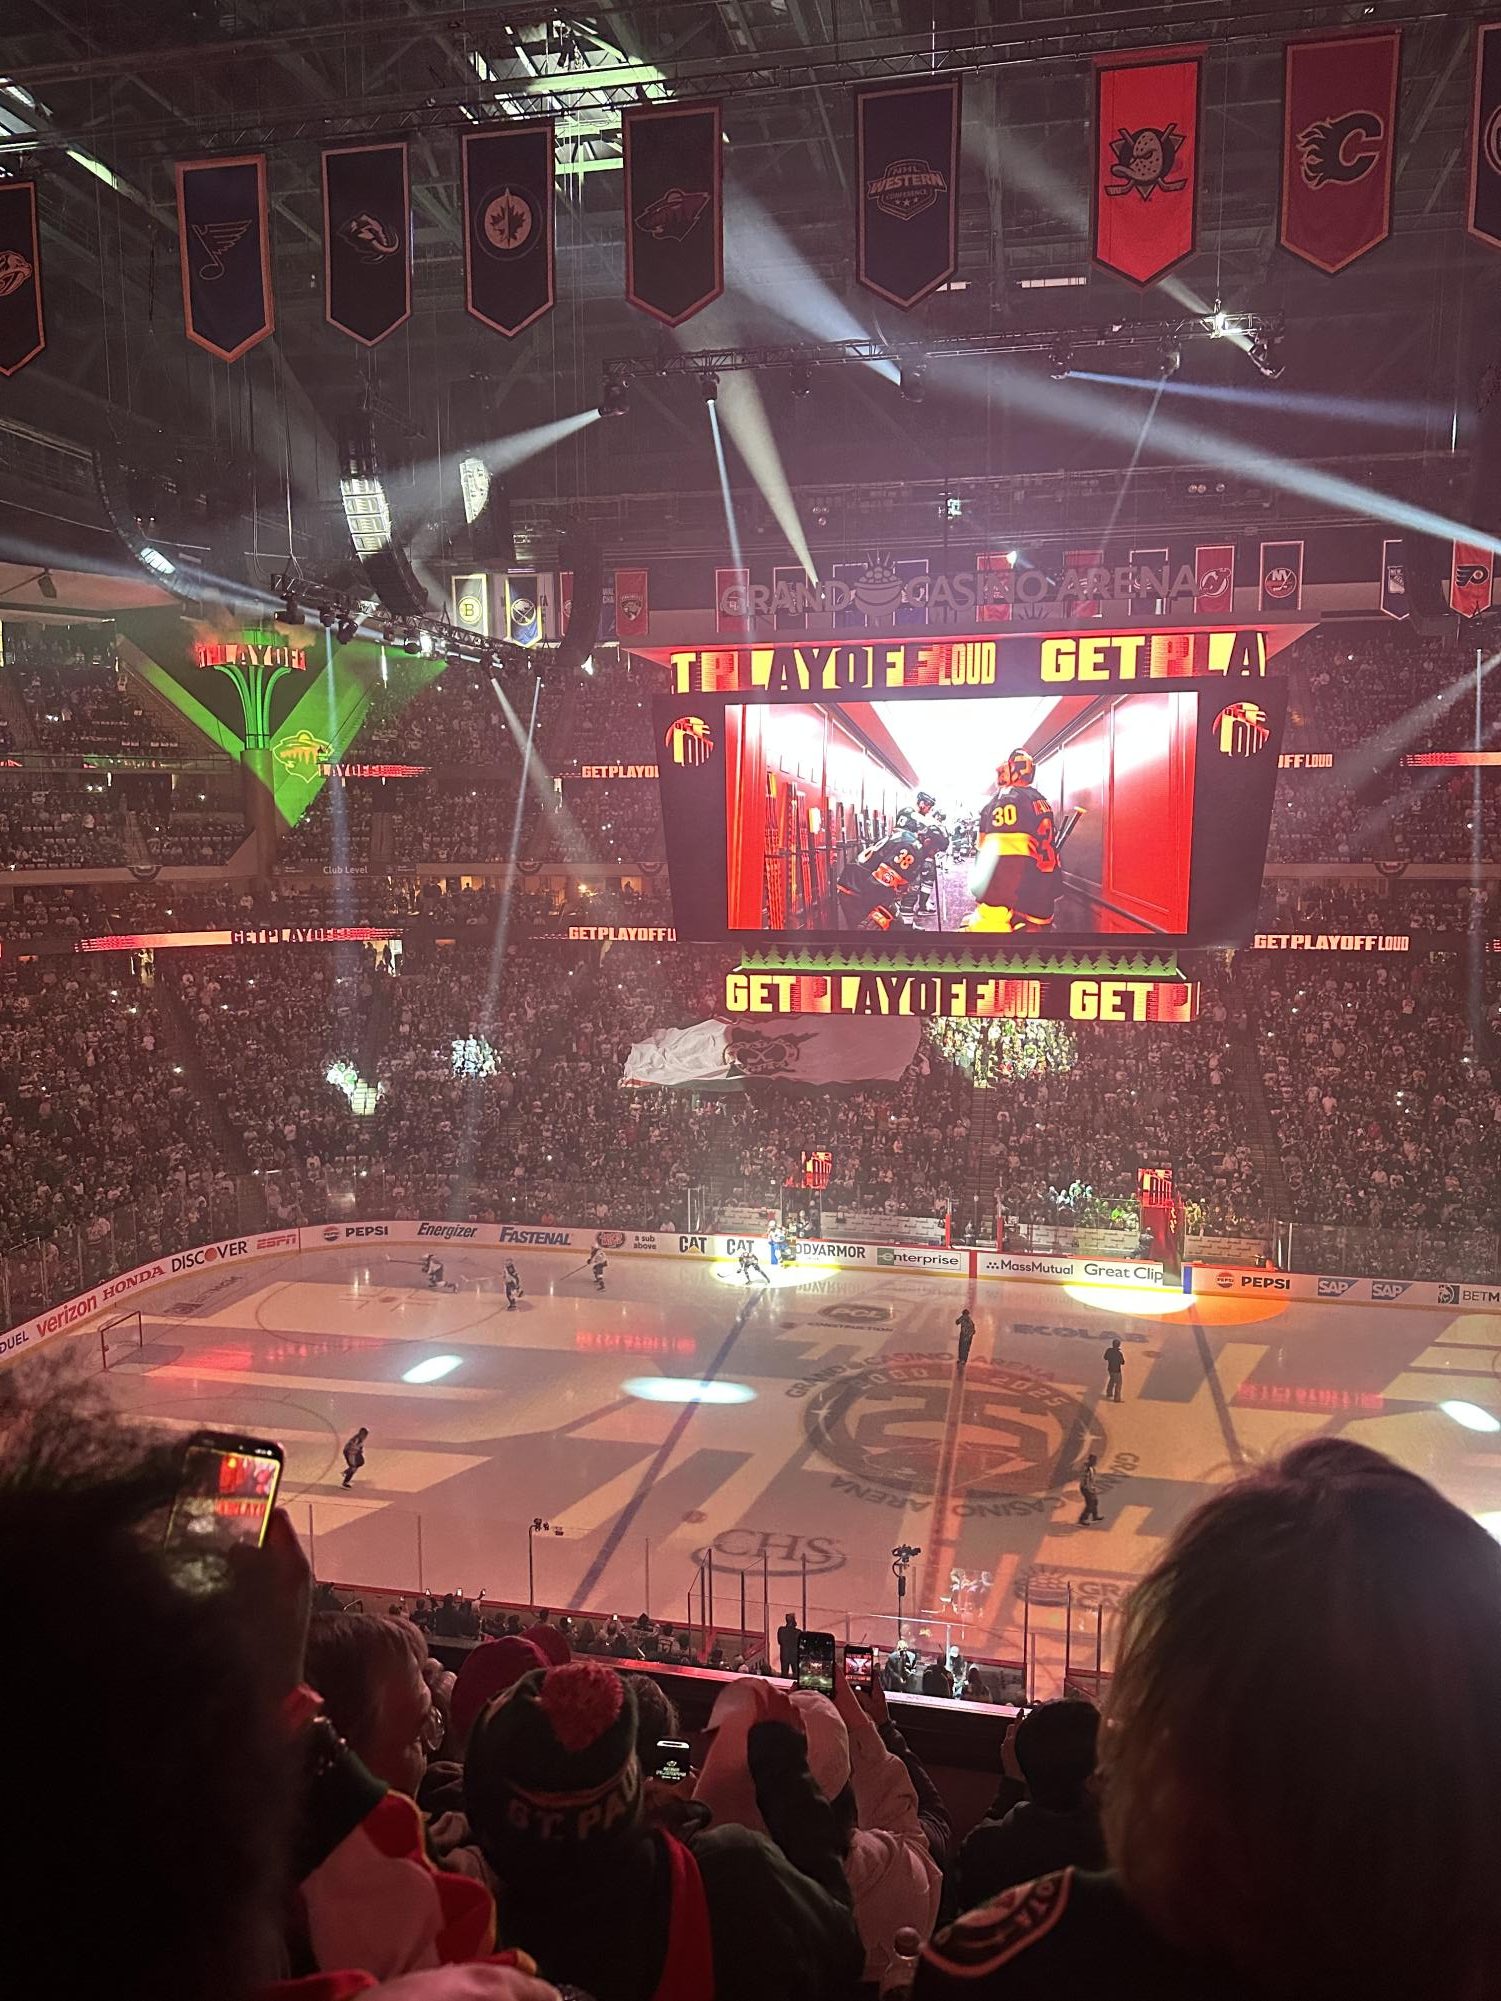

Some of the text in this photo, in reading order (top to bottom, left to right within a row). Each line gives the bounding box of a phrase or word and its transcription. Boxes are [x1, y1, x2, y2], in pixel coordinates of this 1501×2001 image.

[870, 174, 944, 193] WESTERN
[720, 564, 1201, 617] GRAND CASINO ARENA
[992, 804, 1017, 827] 30
[893, 849, 915, 870] 38
[323, 866, 368, 874] Club Level
[345, 1226, 389, 1237] PEPSI
[417, 1222, 478, 1239] Energizer
[499, 1226, 572, 1246] FASTENAL
[256, 1233, 298, 1250] ESPN
[633, 1242, 657, 1250] above
[679, 1236, 708, 1254] CAT
[726, 1238, 755, 1255] CAT
[171, 1240, 249, 1273] DISCOVER
[881, 1251, 959, 1266] enterprise
[1000, 1259, 1074, 1275] MassMutual
[1084, 1263, 1131, 1279] Great
[102, 1264, 167, 1301] HONDA
[1241, 1276, 1291, 1290] PEPSI
[1318, 1280, 1349, 1294] SAP
[1372, 1282, 1404, 1297] SAP
[36, 1294, 98, 1338] verizon
[1013, 1322, 1149, 1344] ECOLAB
[785, 1364, 846, 1399] GRAND
[863, 1351, 955, 1366] CASINO
[990, 1376, 1071, 1407] 2025
[829, 1475, 932, 1514] ARENA
[952, 1496, 1066, 1518] CASINO
[712, 1528, 834, 1565] CHS
